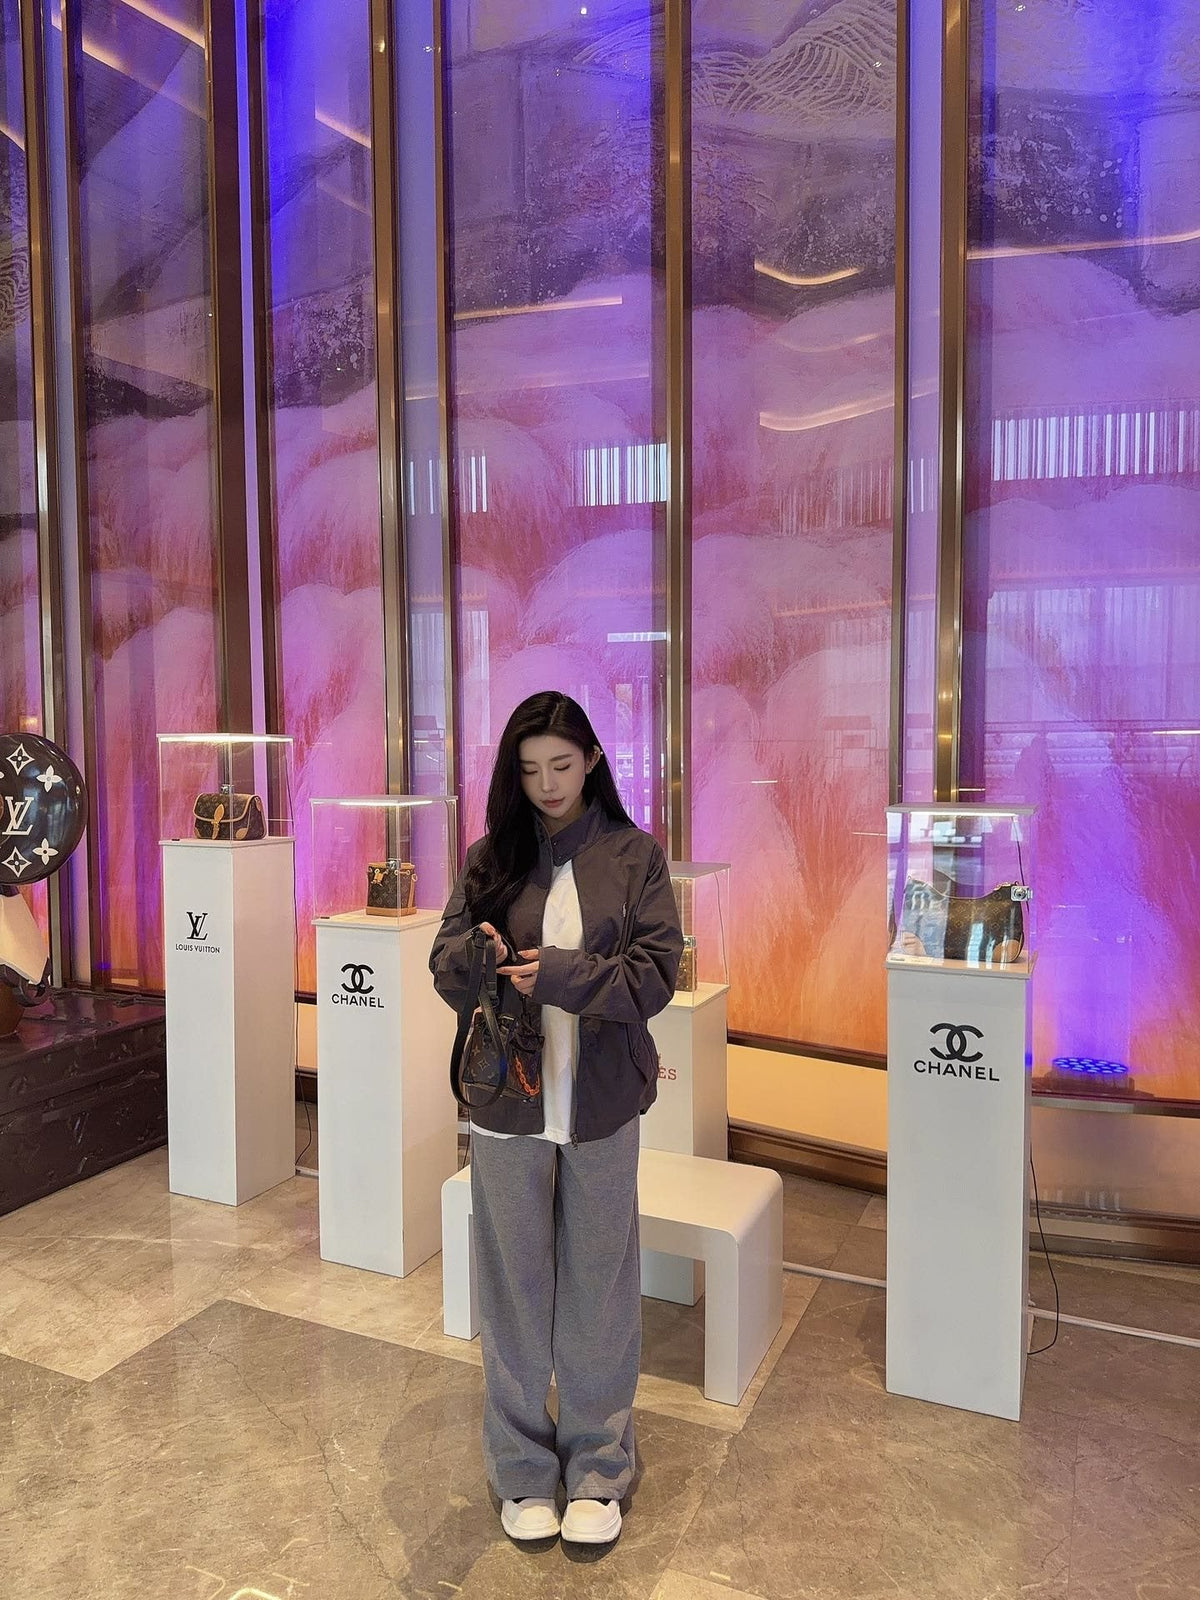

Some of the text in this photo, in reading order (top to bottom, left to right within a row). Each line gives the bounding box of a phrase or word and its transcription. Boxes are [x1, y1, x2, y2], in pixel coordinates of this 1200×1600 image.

[175, 943, 221, 954] LOUIS VUITTON
[331, 993, 385, 1009] CHANEL
[913, 1059, 1000, 1082] CHANEL
